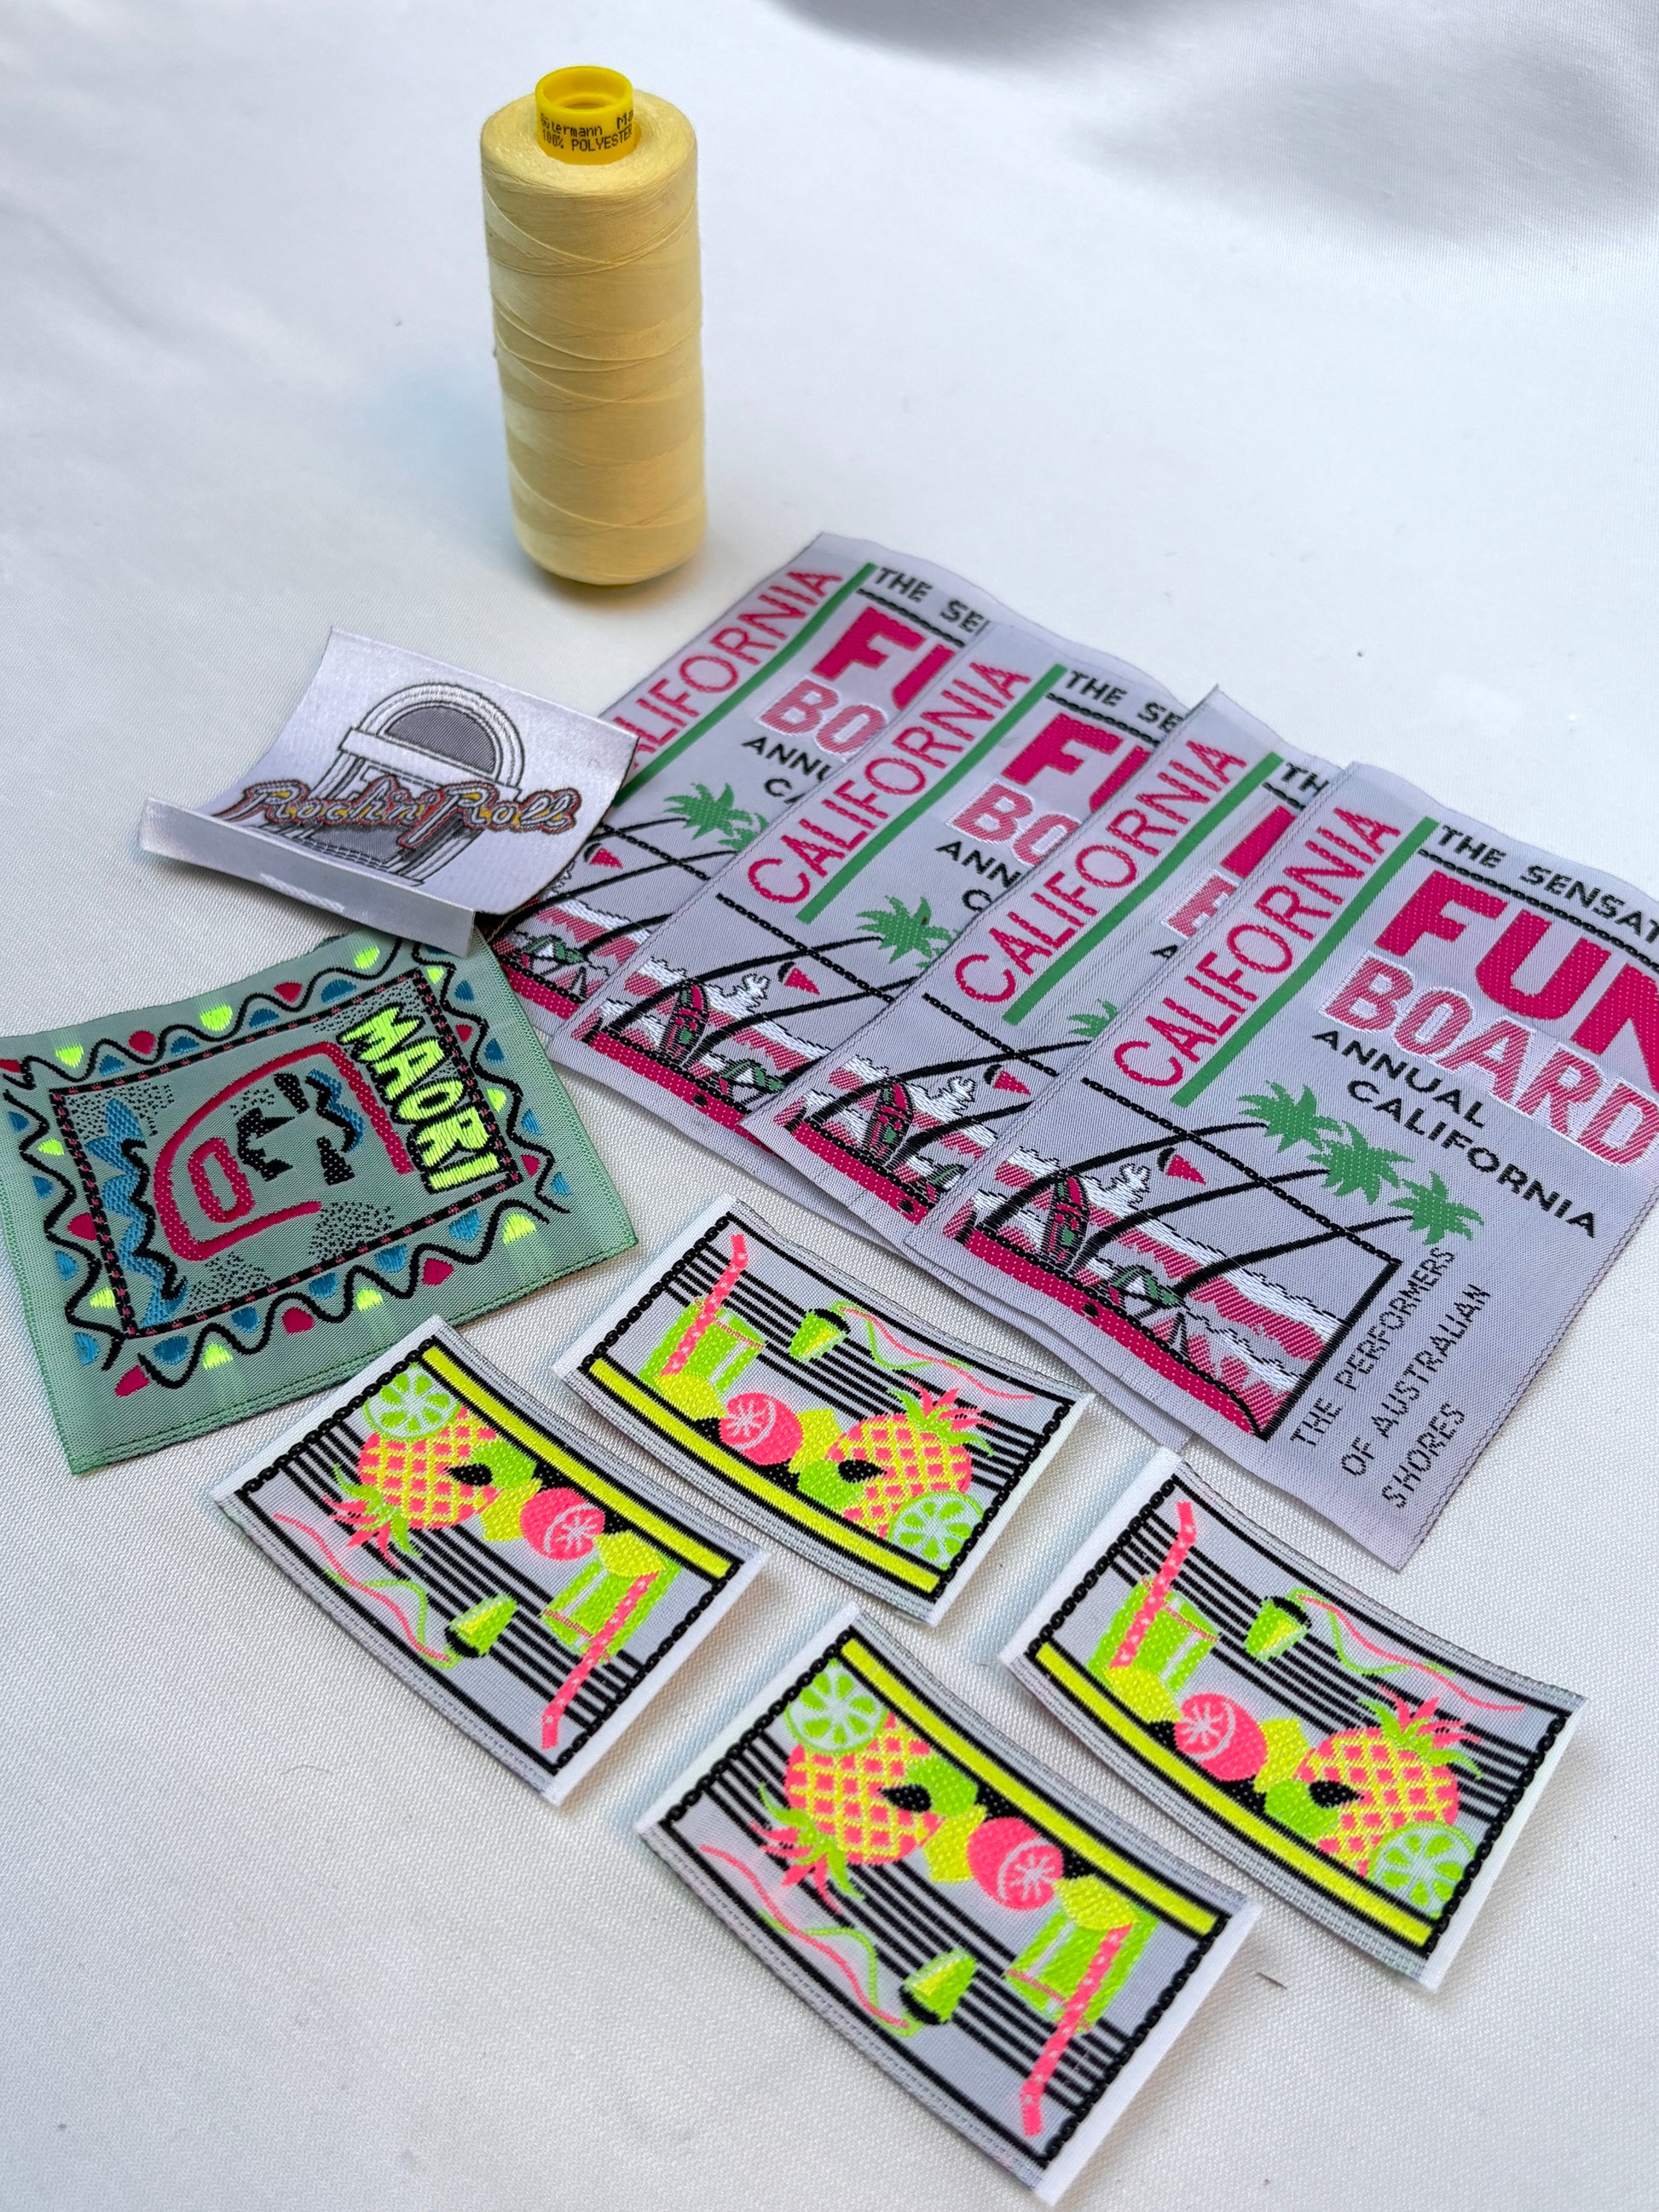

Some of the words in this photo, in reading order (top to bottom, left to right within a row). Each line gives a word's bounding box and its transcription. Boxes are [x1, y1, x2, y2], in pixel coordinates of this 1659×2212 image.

[542, 130, 564, 149] 100%
[571, 124, 633, 152] POLYESTER
[612, 569, 844, 770] LIFORNIA
[875, 567, 934, 604] THE
[748, 661, 1032, 904] CALIFORNIA
[1064, 671, 1128, 707] THE
[955, 741, 1246, 1002] CALIFORNIA
[1437, 824, 1507, 869] THE
[1114, 807, 1402, 1088] CALIFORNIA
[1373, 869, 1659, 1095] FUN
[337, 1002, 503, 1194] MAORI
[1311, 1030, 1486, 1129] ANNUAL
[1318, 950, 1659, 1170] BOARD
[1347, 1080, 1597, 1239] CALIFORNIA
[1290, 1397, 1343, 1448] THE
[1333, 1247, 1455, 1392] PERFORMERS
[1341, 1436, 1376, 1477] OF
[1371, 1284, 1491, 1438] AUSTRALIAN
[1381, 1402, 1465, 1509] SHORES
